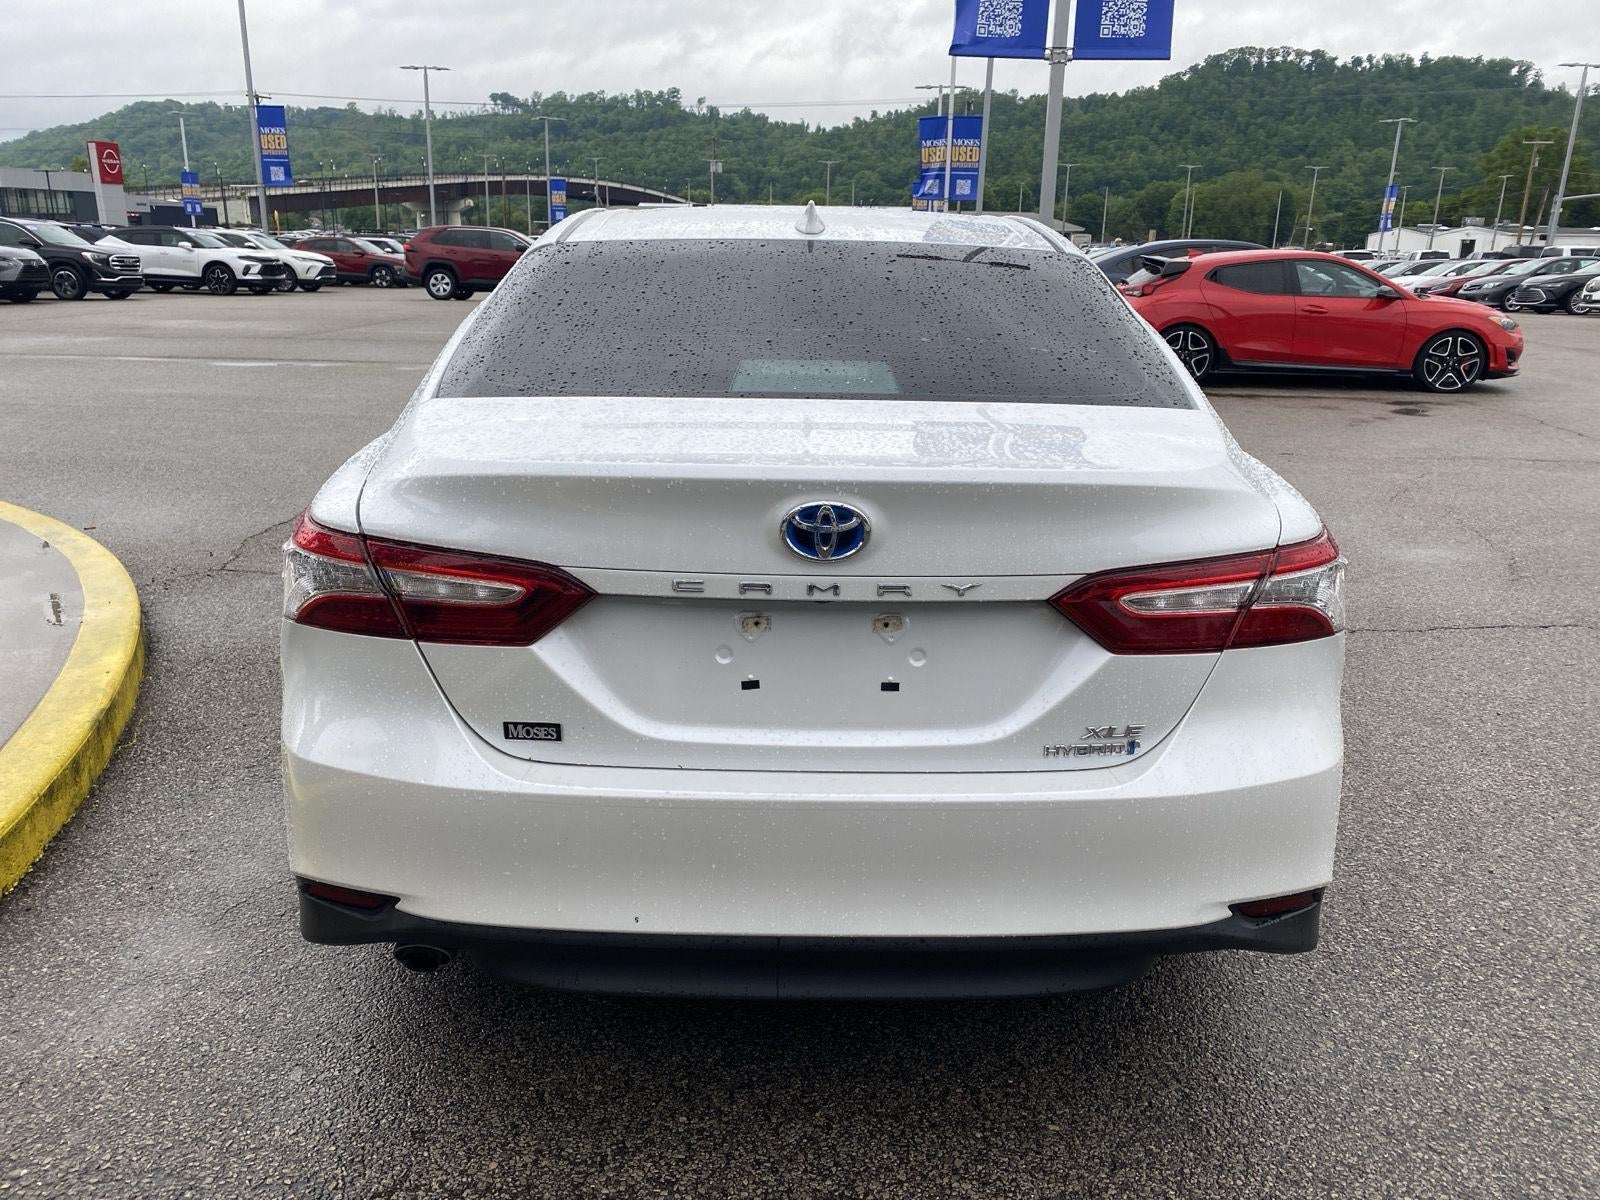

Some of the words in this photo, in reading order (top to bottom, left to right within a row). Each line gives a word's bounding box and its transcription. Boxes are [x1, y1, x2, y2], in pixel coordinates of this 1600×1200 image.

[260, 134, 287, 149] USED
[921, 139, 947, 147] MOSES
[922, 147, 947, 162] USED
[951, 146, 979, 161] USED
[672, 577, 983, 597] CAMRY
[1080, 724, 1146, 740] XLE
[1043, 743, 1126, 757] HYBRID
